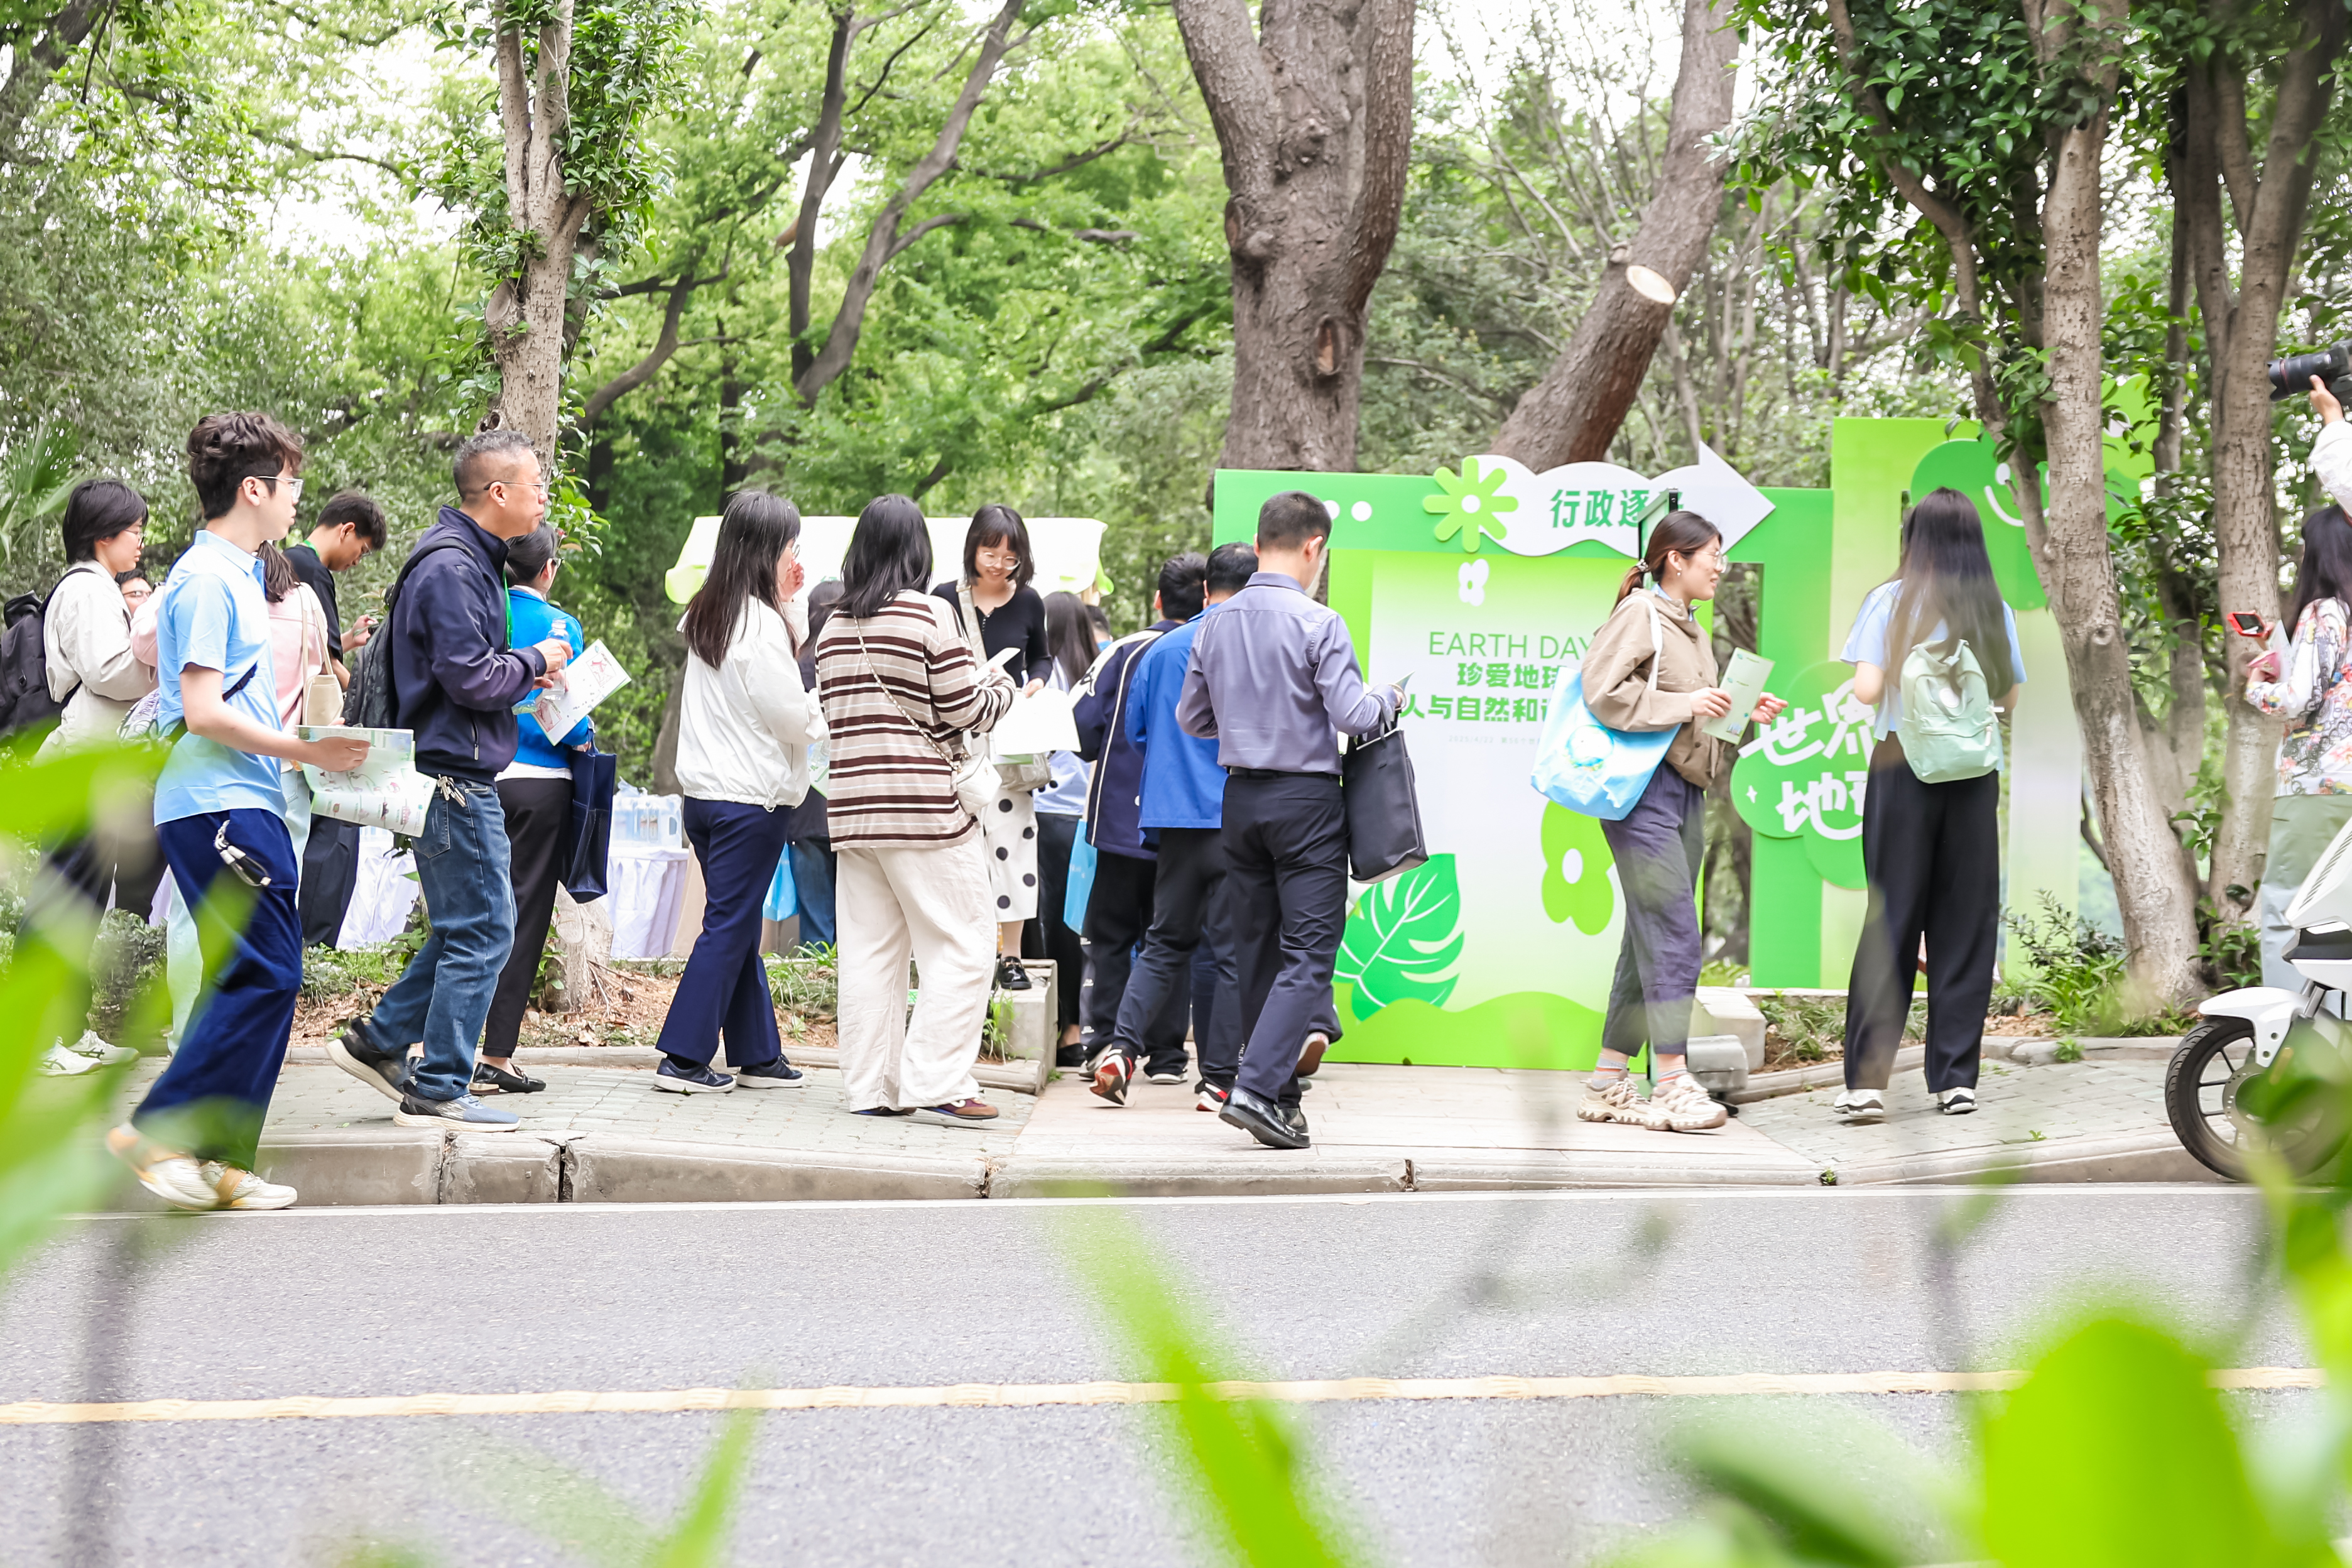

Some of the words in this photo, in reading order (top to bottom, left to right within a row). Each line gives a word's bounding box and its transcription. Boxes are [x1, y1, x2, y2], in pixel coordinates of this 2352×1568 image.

[1549, 489, 1684, 528] 行政逐
[1429, 631, 1527, 658] EARTH
[1400, 694, 1548, 722] 人与自然和
